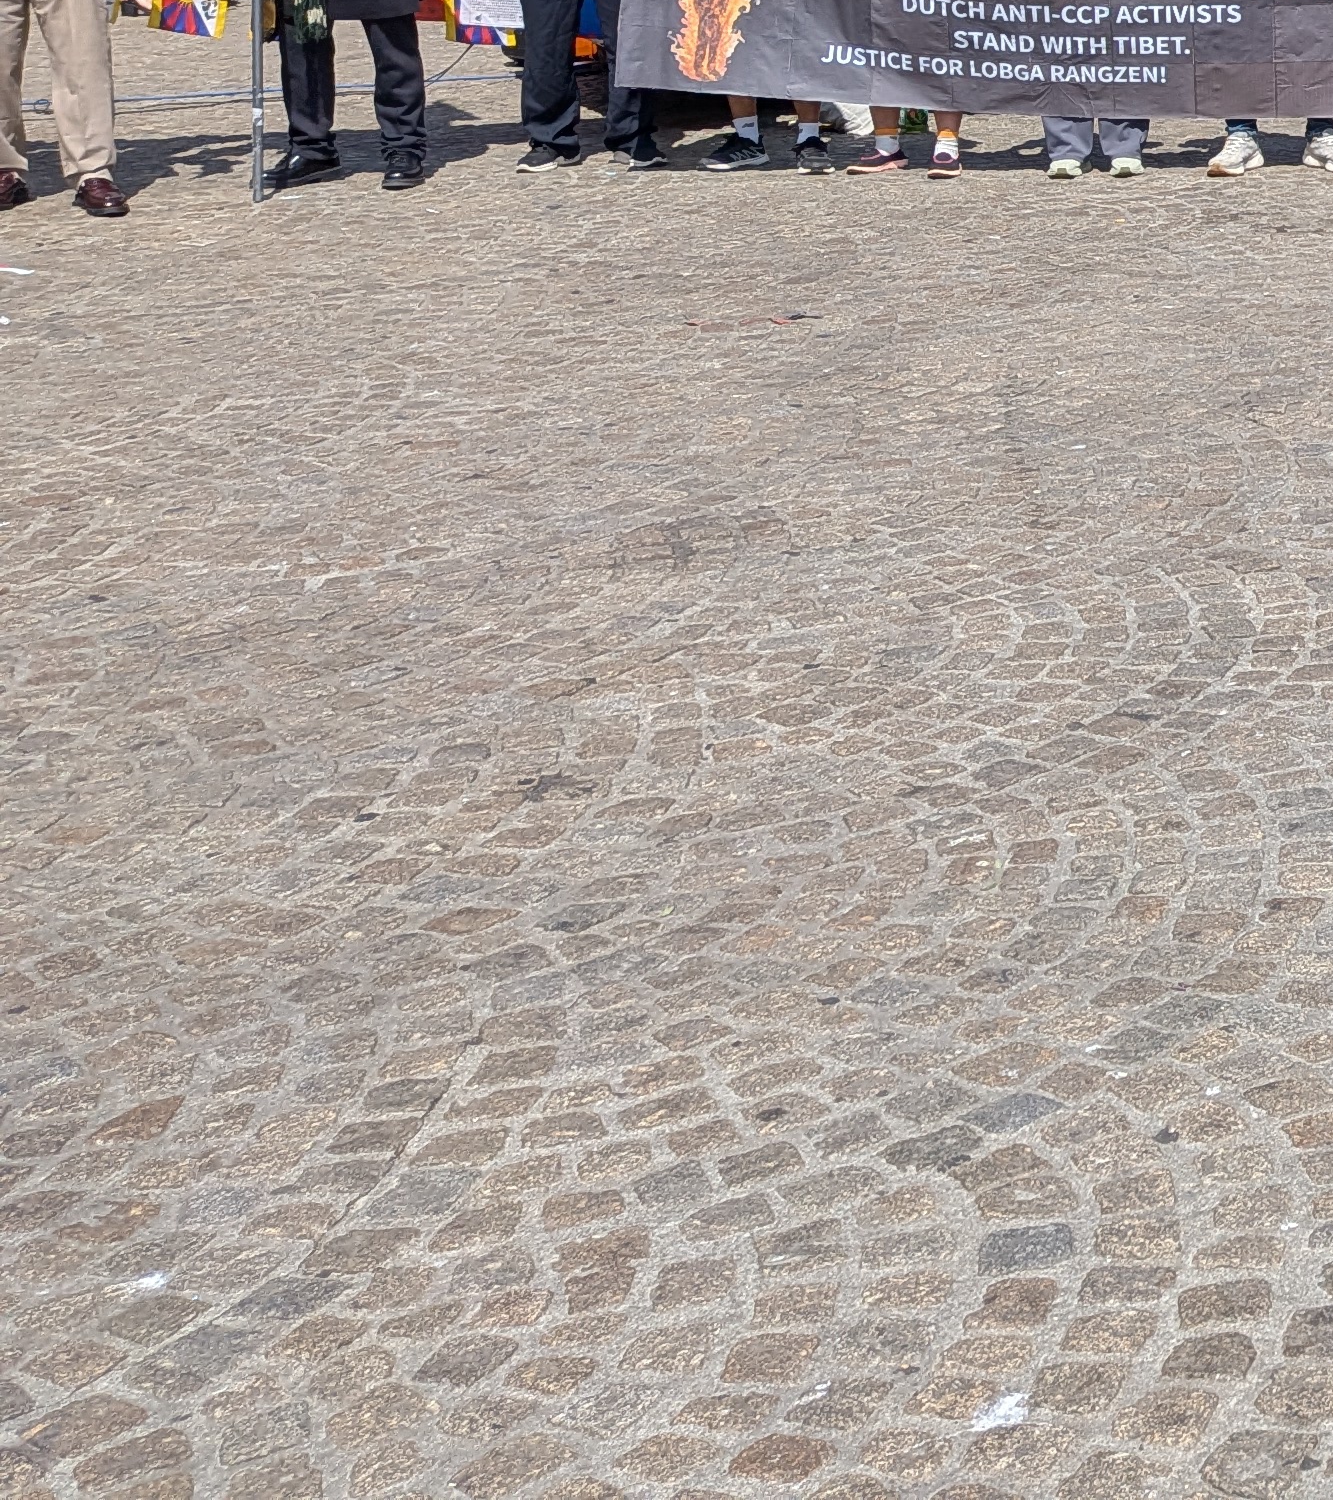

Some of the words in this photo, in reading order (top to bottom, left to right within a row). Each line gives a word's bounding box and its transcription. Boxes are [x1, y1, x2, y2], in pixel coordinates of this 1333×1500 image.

[991, 4, 1110, 25] ANTI-CCP
[1115, 4, 1242, 25] ACTIVISTS
[953, 30, 1035, 53] STAND
[1041, 35, 1107, 56] WITH
[1113, 35, 1191, 56] TIBET.
[820, 44, 914, 72] JUSTICE
[918, 55, 965, 78] FOR
[969, 59, 1045, 82] LOBGA
[1050, 64, 1167, 84] RANGZEN!
